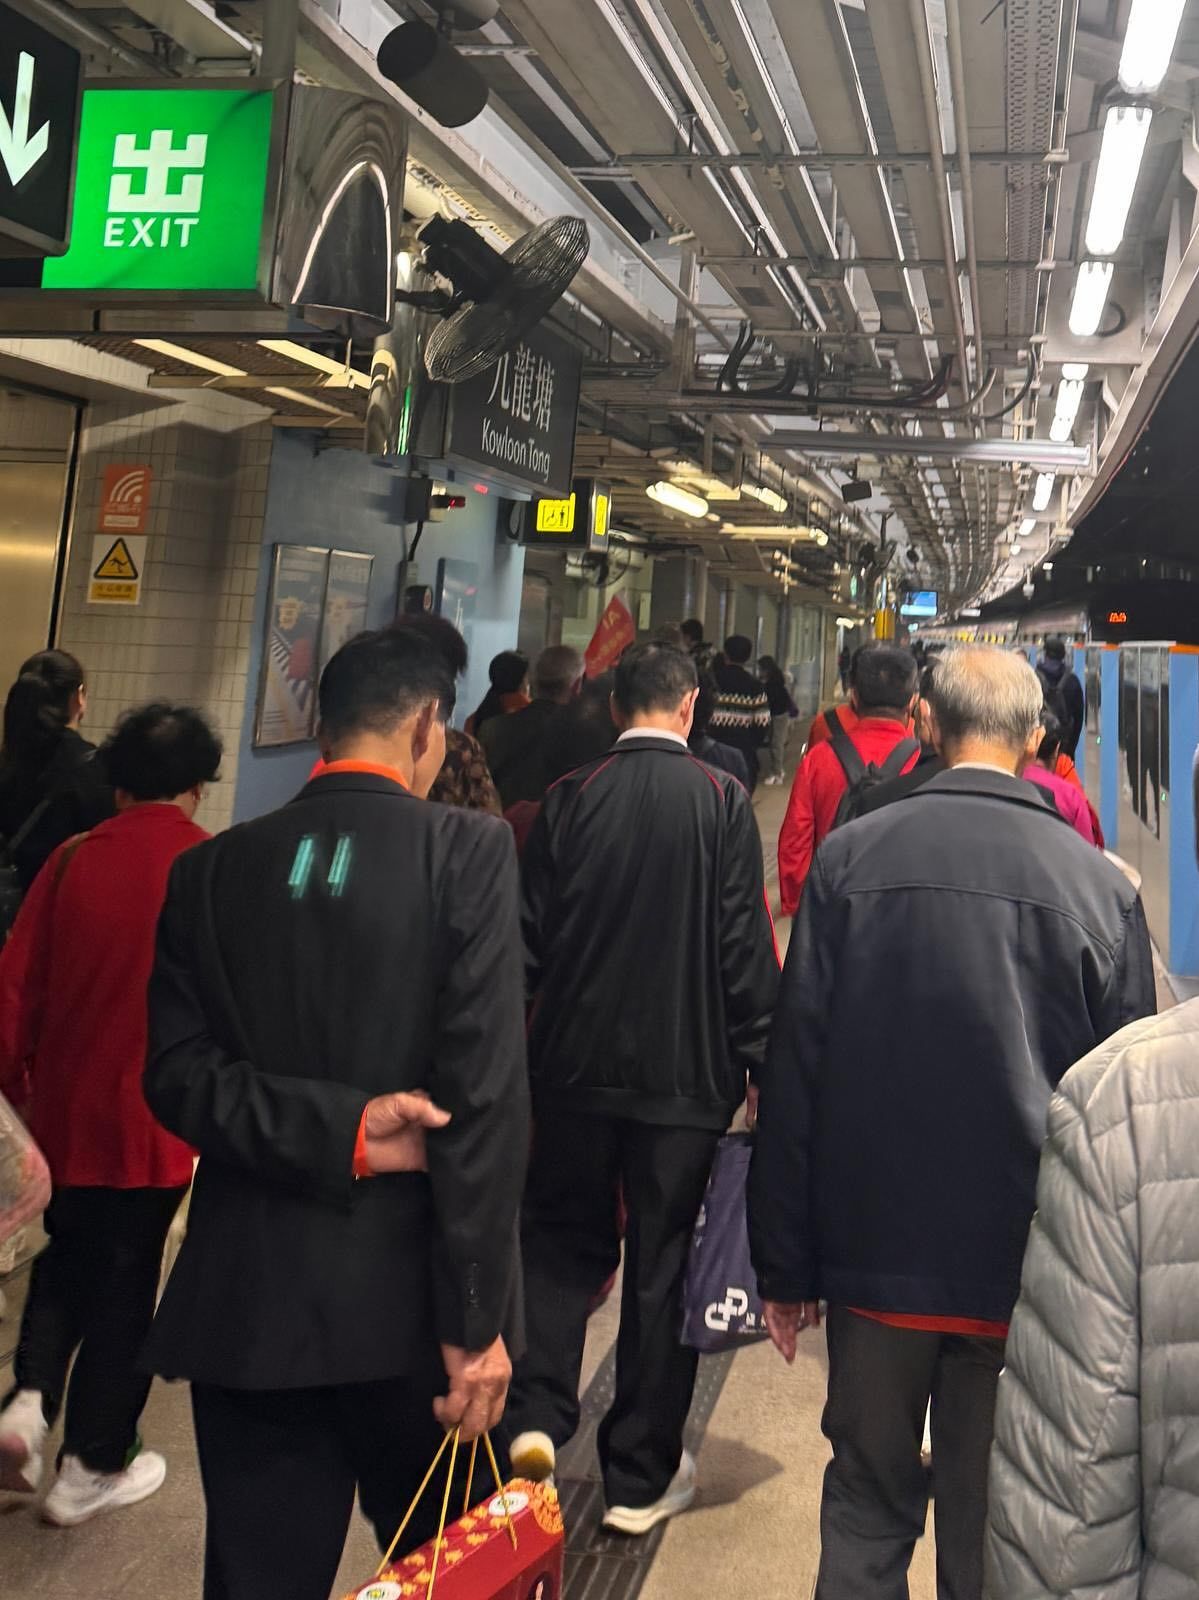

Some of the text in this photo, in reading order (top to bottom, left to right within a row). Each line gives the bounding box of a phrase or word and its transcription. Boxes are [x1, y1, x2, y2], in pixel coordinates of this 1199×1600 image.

[107, 129, 208, 213] 出
[103, 217, 200, 247] EXIT
[487, 341, 555, 433] 九龍塘
[481, 417, 550, 483] Kowloon Tong
